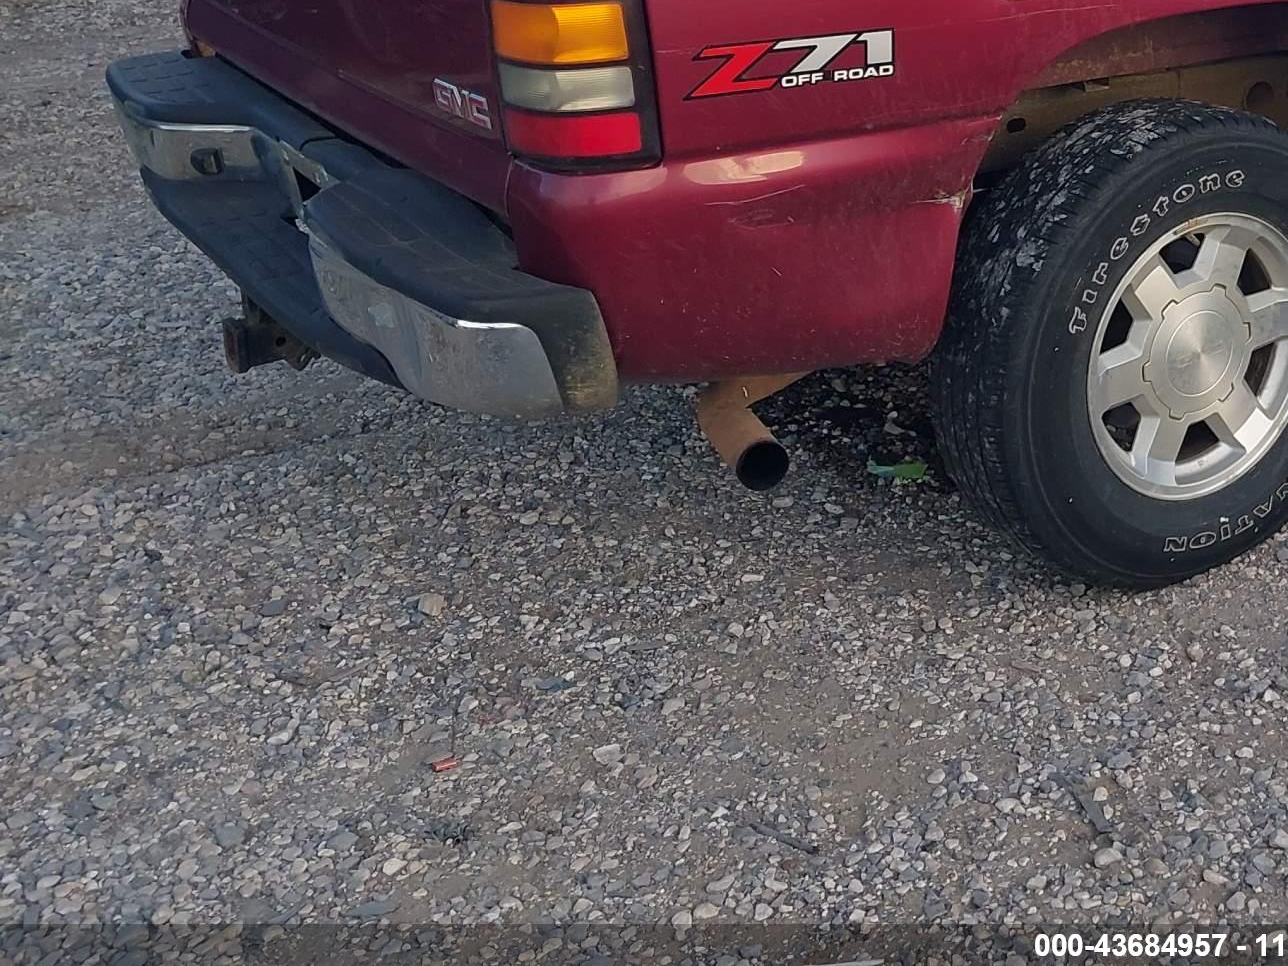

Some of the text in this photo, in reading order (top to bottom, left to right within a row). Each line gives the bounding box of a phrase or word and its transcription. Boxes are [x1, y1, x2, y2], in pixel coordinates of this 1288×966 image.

[683, 28, 894, 100] Z71
[780, 64, 894, 88] OFF ROAD
[432, 78, 493, 131] GMC
[1068, 169, 1245, 334] Firestone
